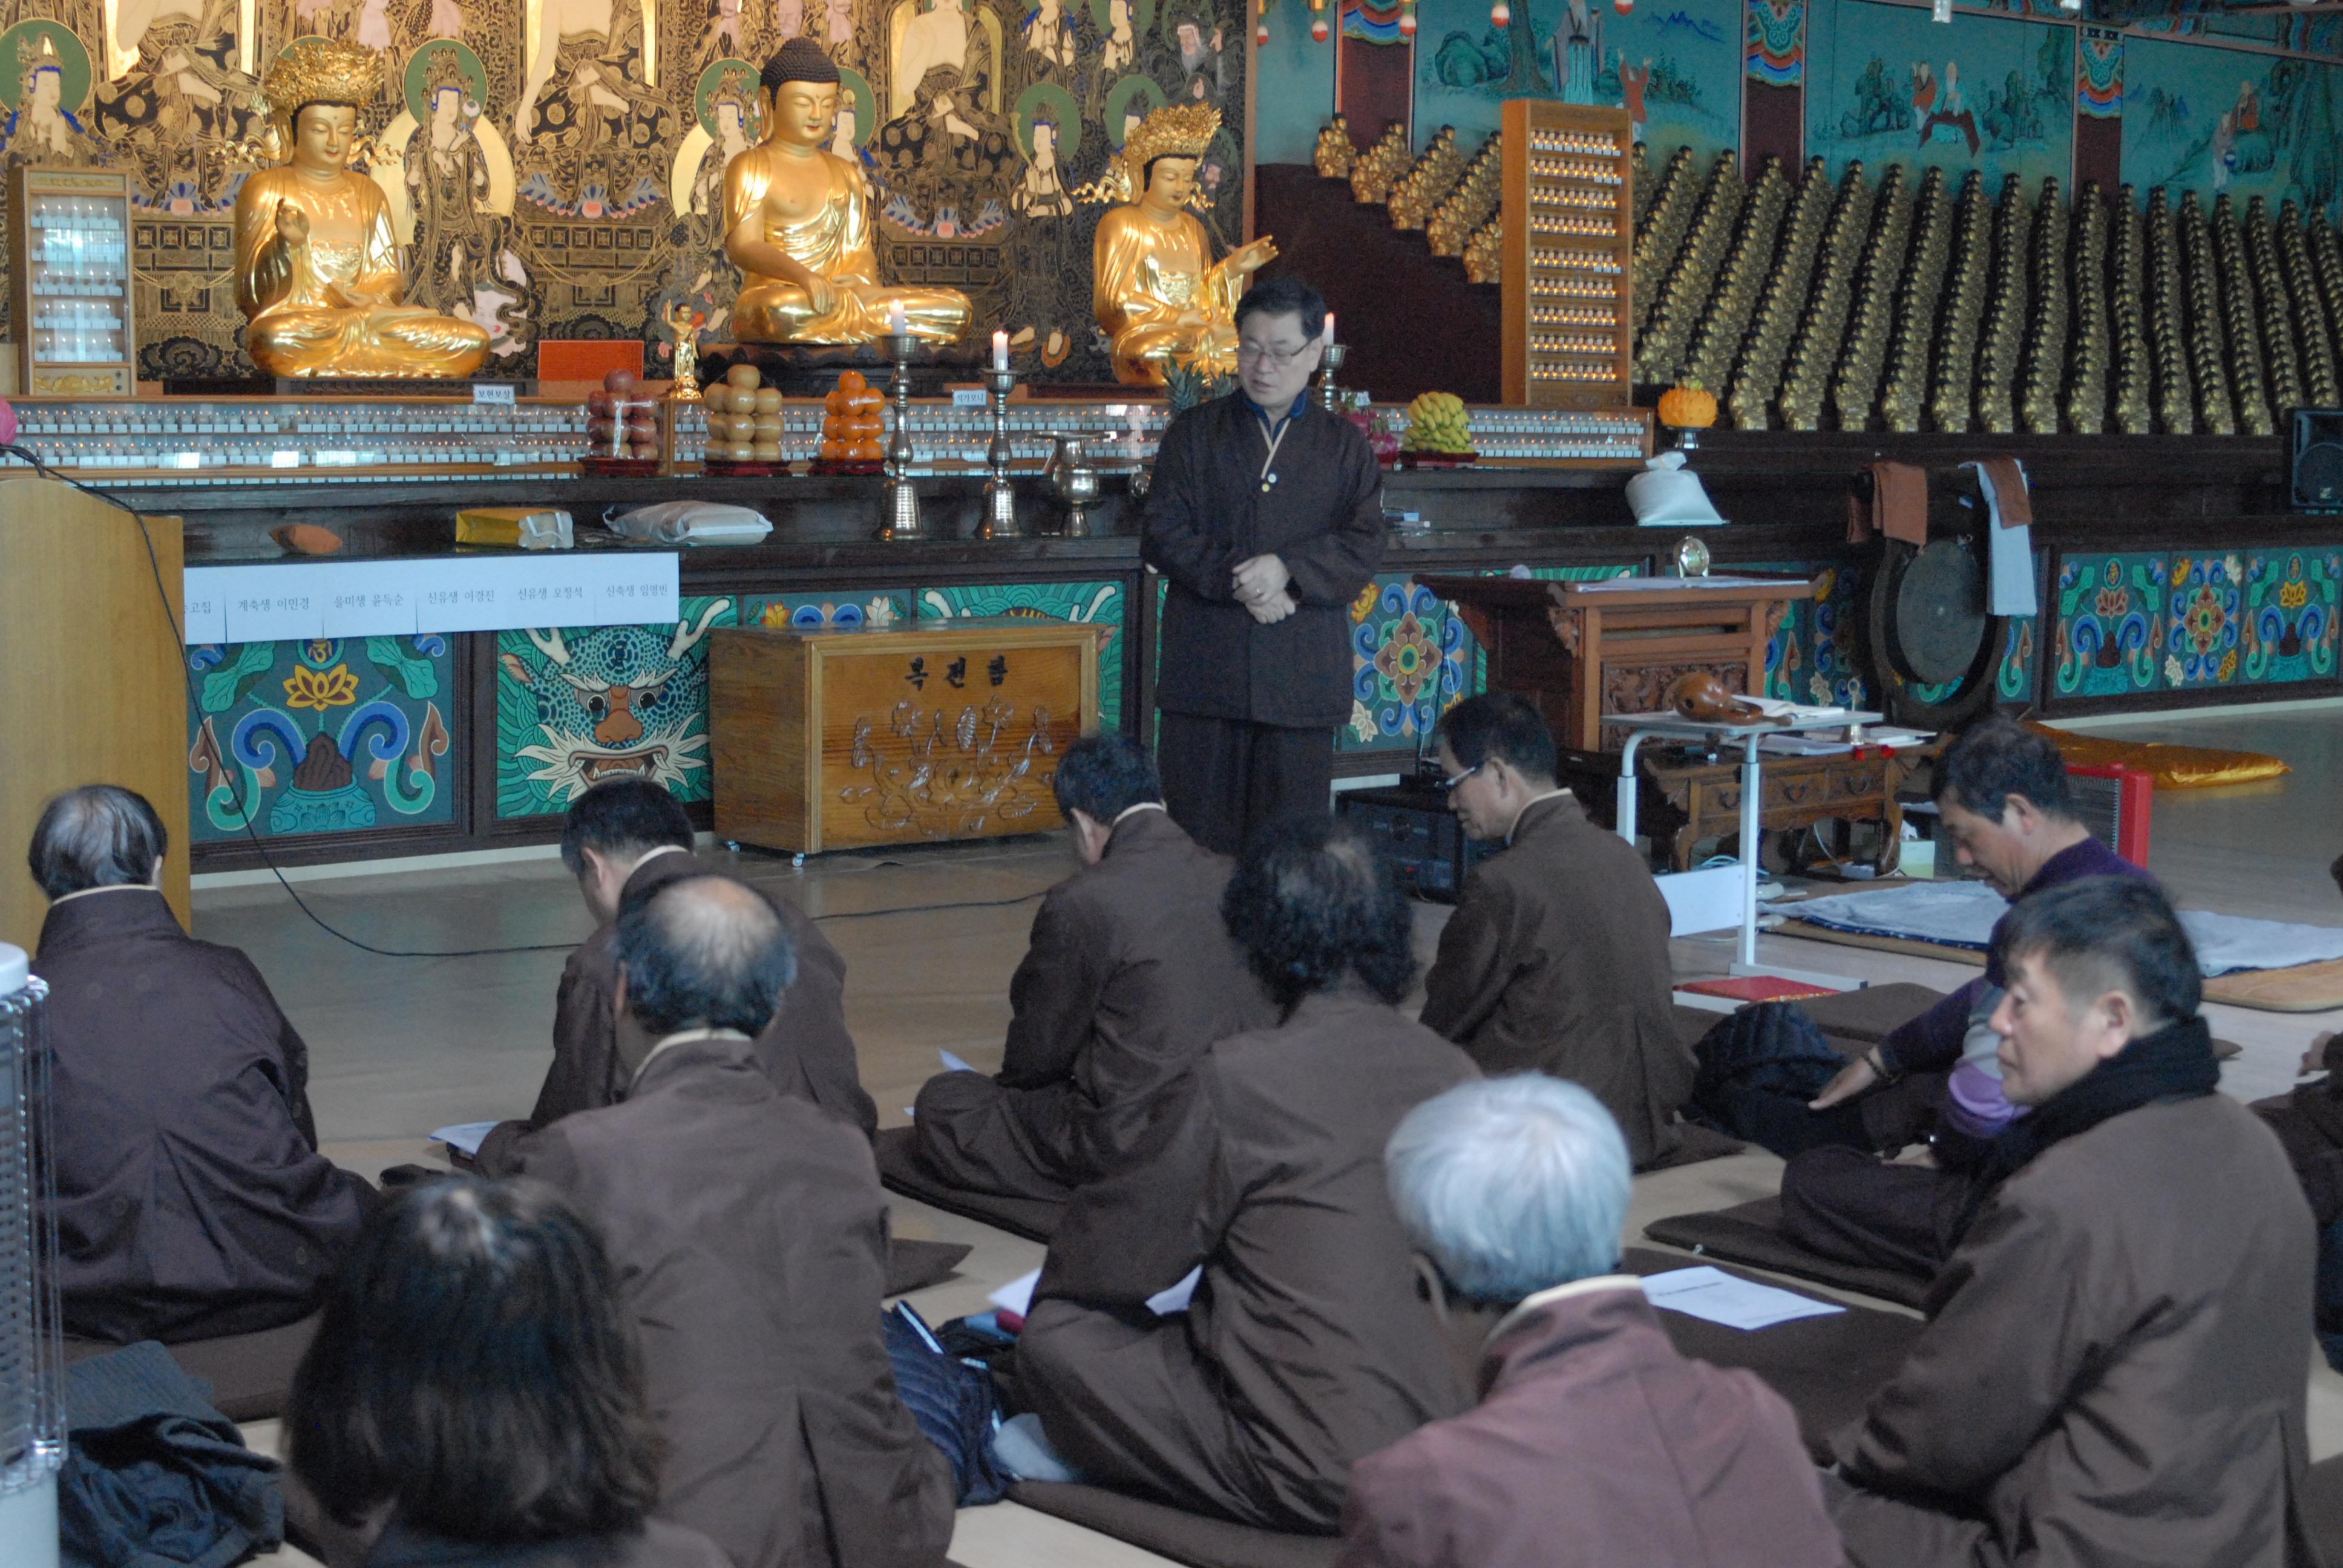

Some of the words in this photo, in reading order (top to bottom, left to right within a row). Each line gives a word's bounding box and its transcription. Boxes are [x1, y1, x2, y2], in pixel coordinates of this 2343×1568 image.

[479, 390, 510, 400] 보현보살
[957, 393, 983, 402] 석가모니
[428, 590, 458, 604] 신유생
[464, 589, 494, 603] 이경진
[519, 587, 547, 600] 신유생
[552, 586, 583, 599] 오정석
[606, 584, 635, 597] 신축생
[640, 584, 667, 596] 임영빈
[185, 601, 211, 614] 고집
[238, 598, 270, 612] 계축생
[277, 597, 309, 610] 이민경
[334, 595, 365, 609] 을미생
[372, 593, 404, 607] 윤득순
